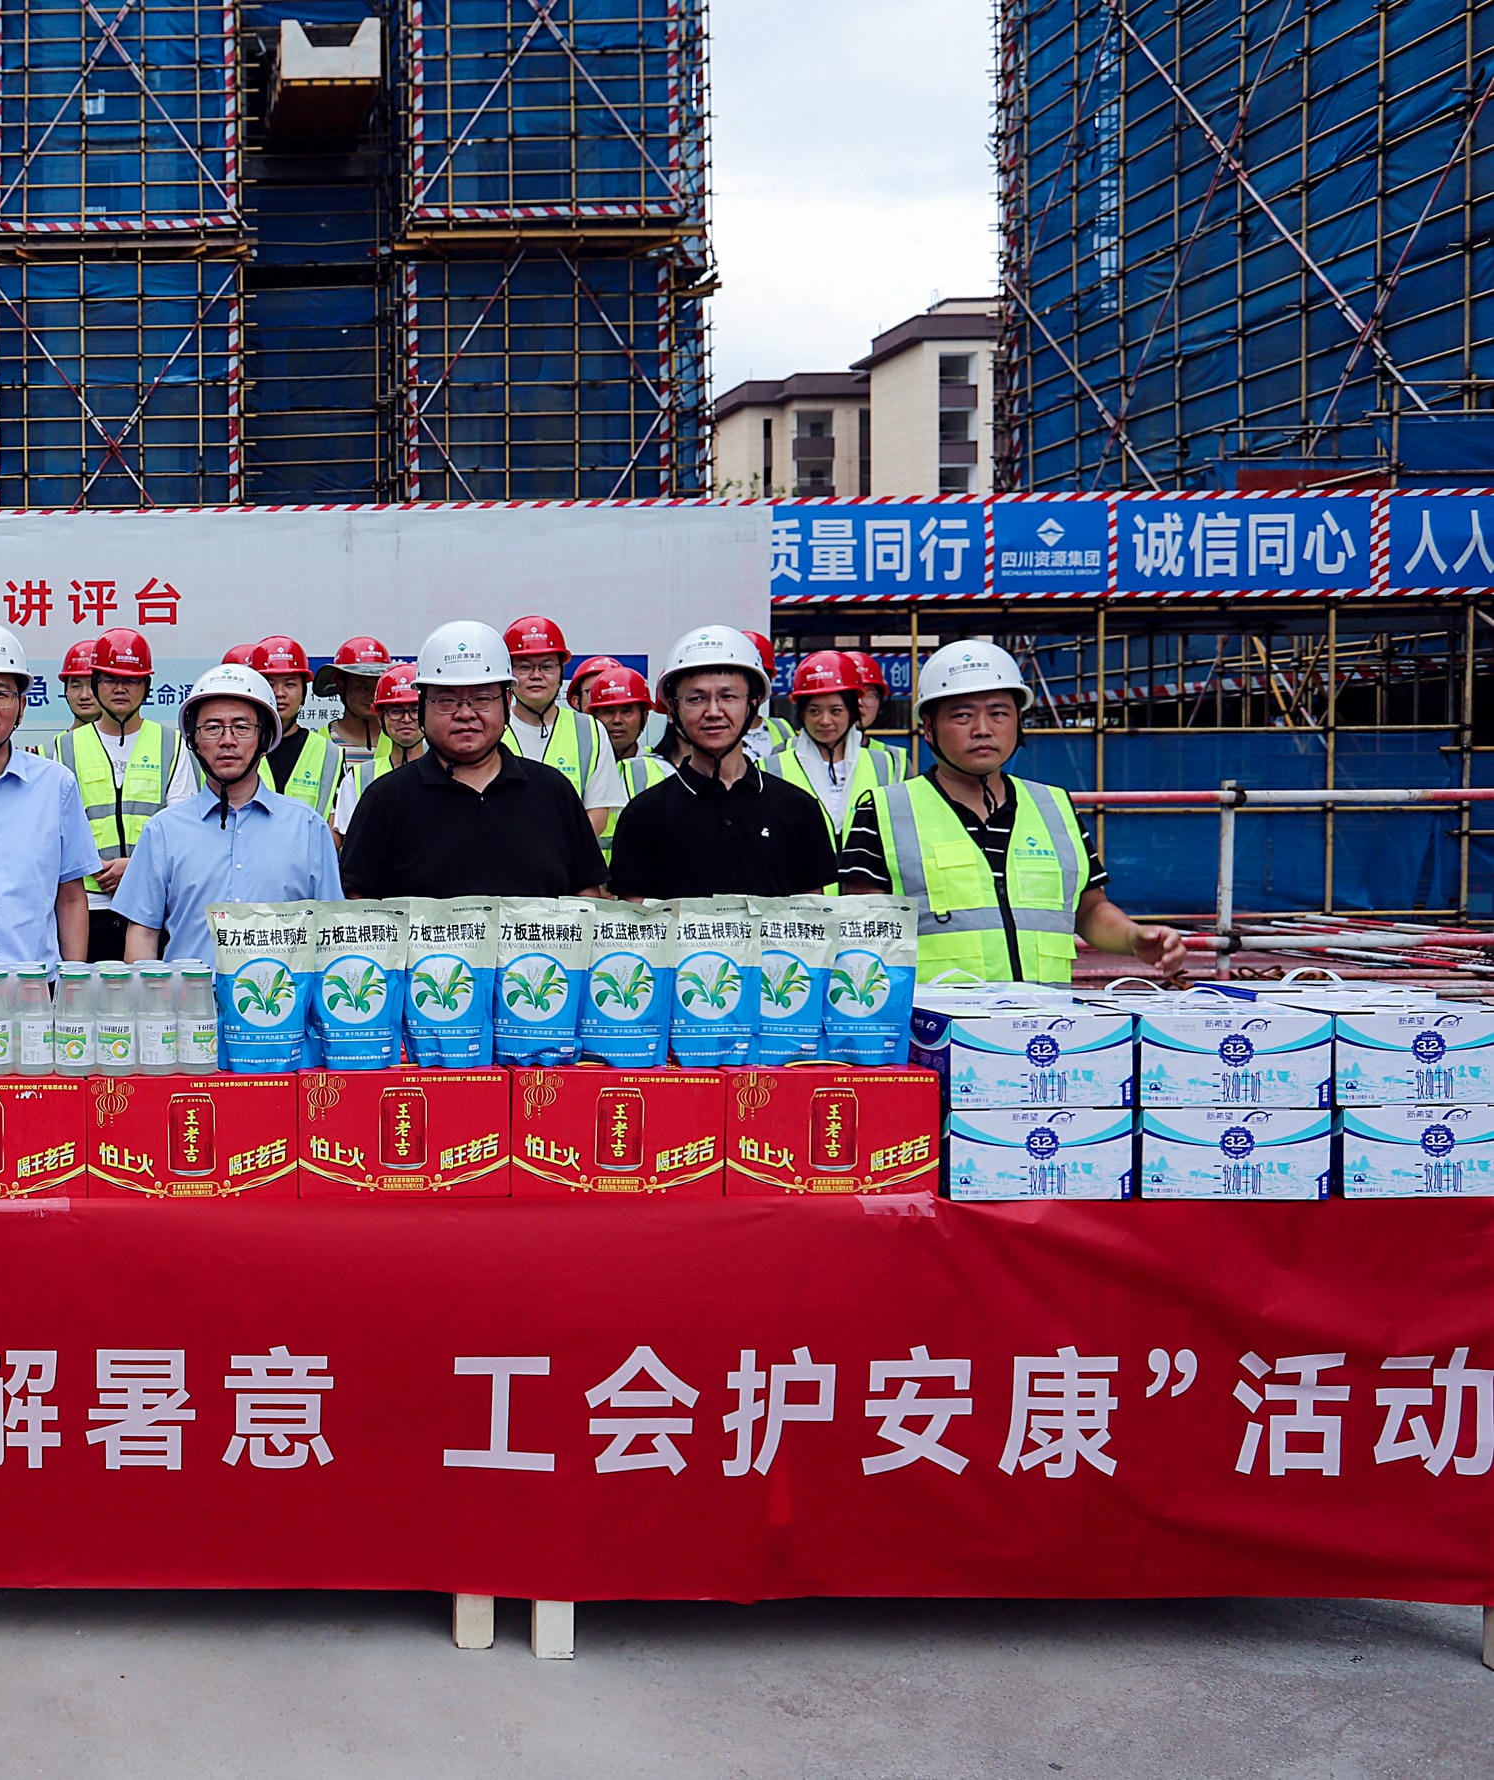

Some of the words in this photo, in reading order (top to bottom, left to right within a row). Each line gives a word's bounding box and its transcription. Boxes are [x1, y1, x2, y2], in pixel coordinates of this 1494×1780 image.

[771, 518, 971, 582] 质量同行
[1001, 550, 1101, 568] 四川资源集团
[1131, 509, 1356, 578] 诚信同心
[444, 653, 482, 661] 四川资源集团
[217, 929, 308, 946] 复方板蓝根颗粒
[183, 1110, 200, 1163] 王老吉
[394, 1104, 411, 1156] 王老吉
[611, 1104, 628, 1158] 王老吉
[825, 1104, 843, 1158] 王老吉
[18, 1142, 75, 1178] 喝王老吉
[99, 1141, 154, 1177] 怕上火
[228, 1138, 287, 1176] 喝王老吉
[310, 1135, 366, 1171] 怕上火
[440, 1132, 500, 1171] 喝王老吉
[525, 1134, 581, 1172] 怕上火
[656, 1136, 716, 1173] 喝王老吉
[739, 1136, 795, 1172] 怕上火
[870, 1135, 931, 1173] 喝王老吉
